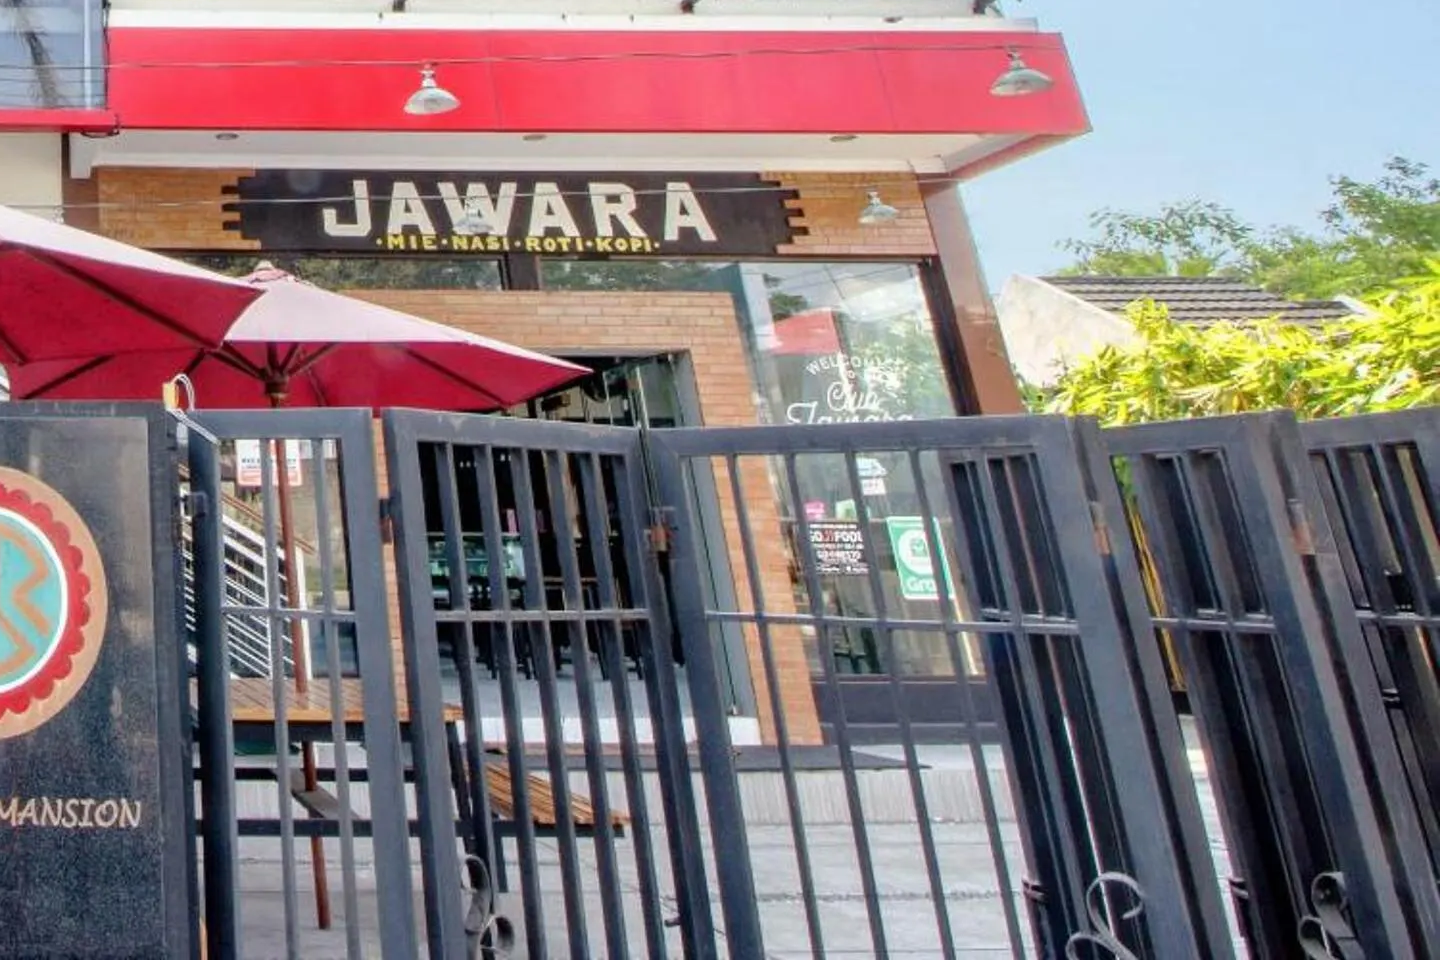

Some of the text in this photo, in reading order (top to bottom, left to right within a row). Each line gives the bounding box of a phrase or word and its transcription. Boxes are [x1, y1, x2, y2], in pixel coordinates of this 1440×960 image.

[323, 179, 717, 242] JAWARA
[386, 234, 652, 253] MIE NASI ROTI KOPI
